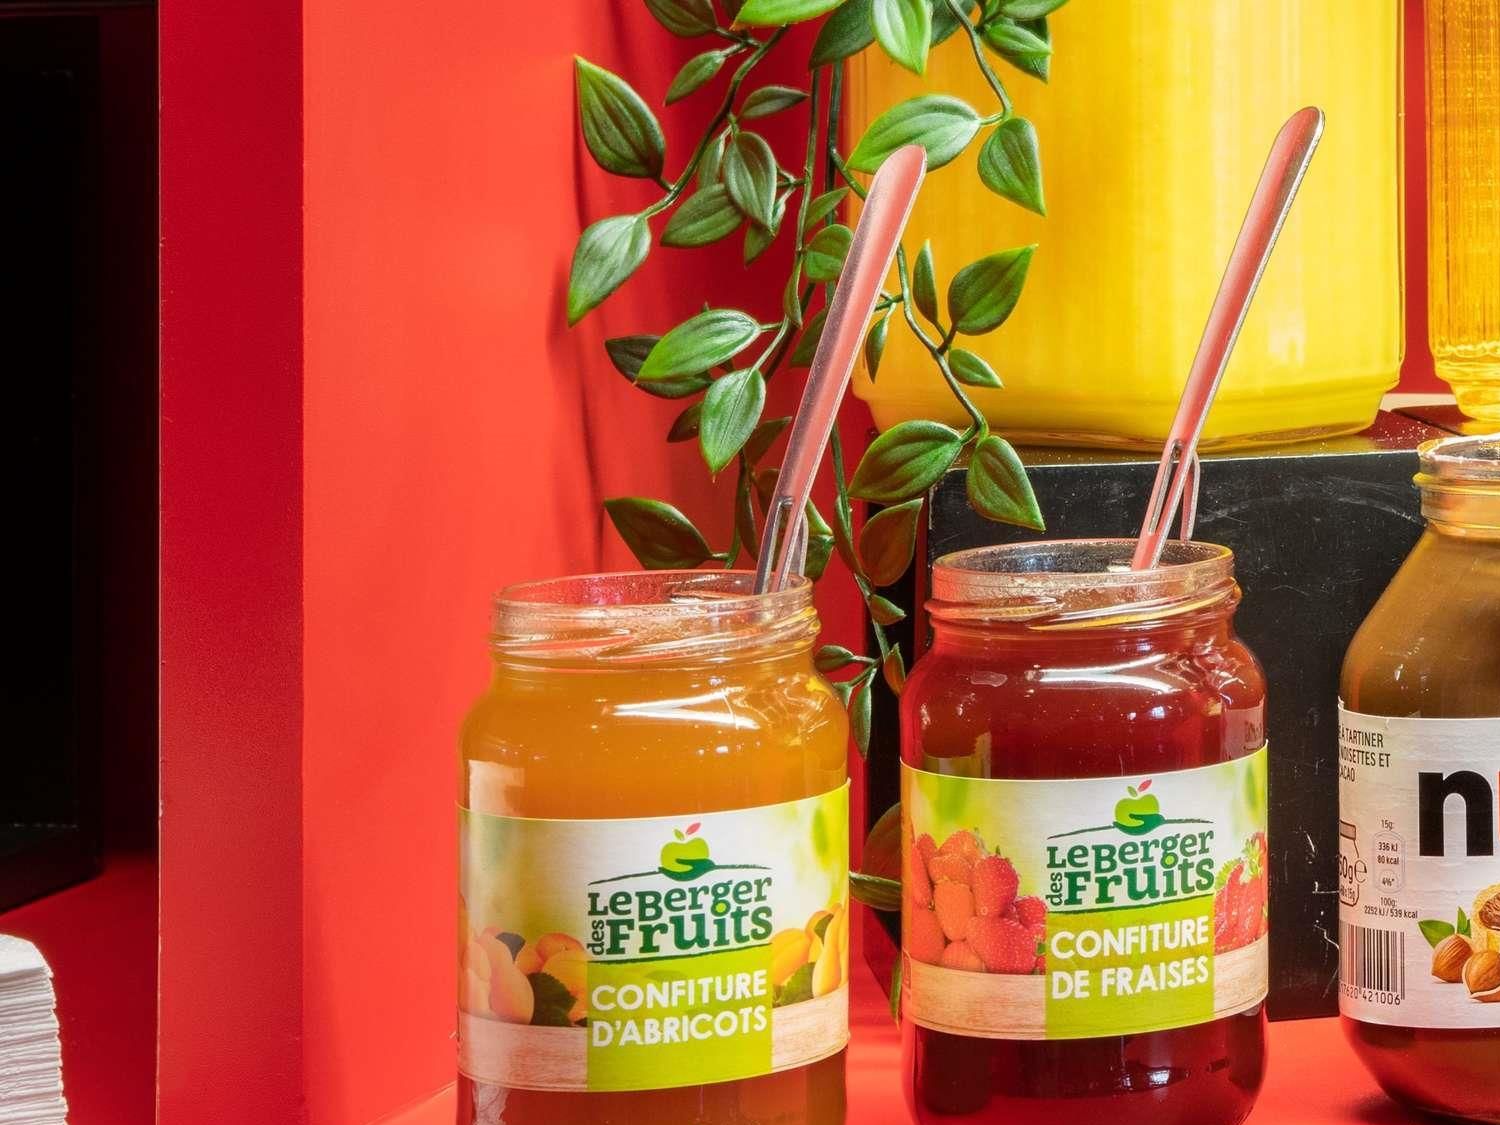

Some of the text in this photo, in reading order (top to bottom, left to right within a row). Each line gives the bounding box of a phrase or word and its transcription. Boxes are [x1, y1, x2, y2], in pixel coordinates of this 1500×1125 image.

[1346, 727, 1384, 748] TARTINER
[1339, 765, 1356, 782] ACAO
[1379, 753, 1391, 768] ET
[1046, 857, 1215, 906] des Fruits
[587, 906, 773, 956] des Fruits
[1051, 915, 1209, 959] CONFITURE
[591, 969, 767, 1011] CONFITURE
[1052, 956, 1209, 999] DE FRAISES
[592, 1006, 767, 1047] D'ABRICOTS
